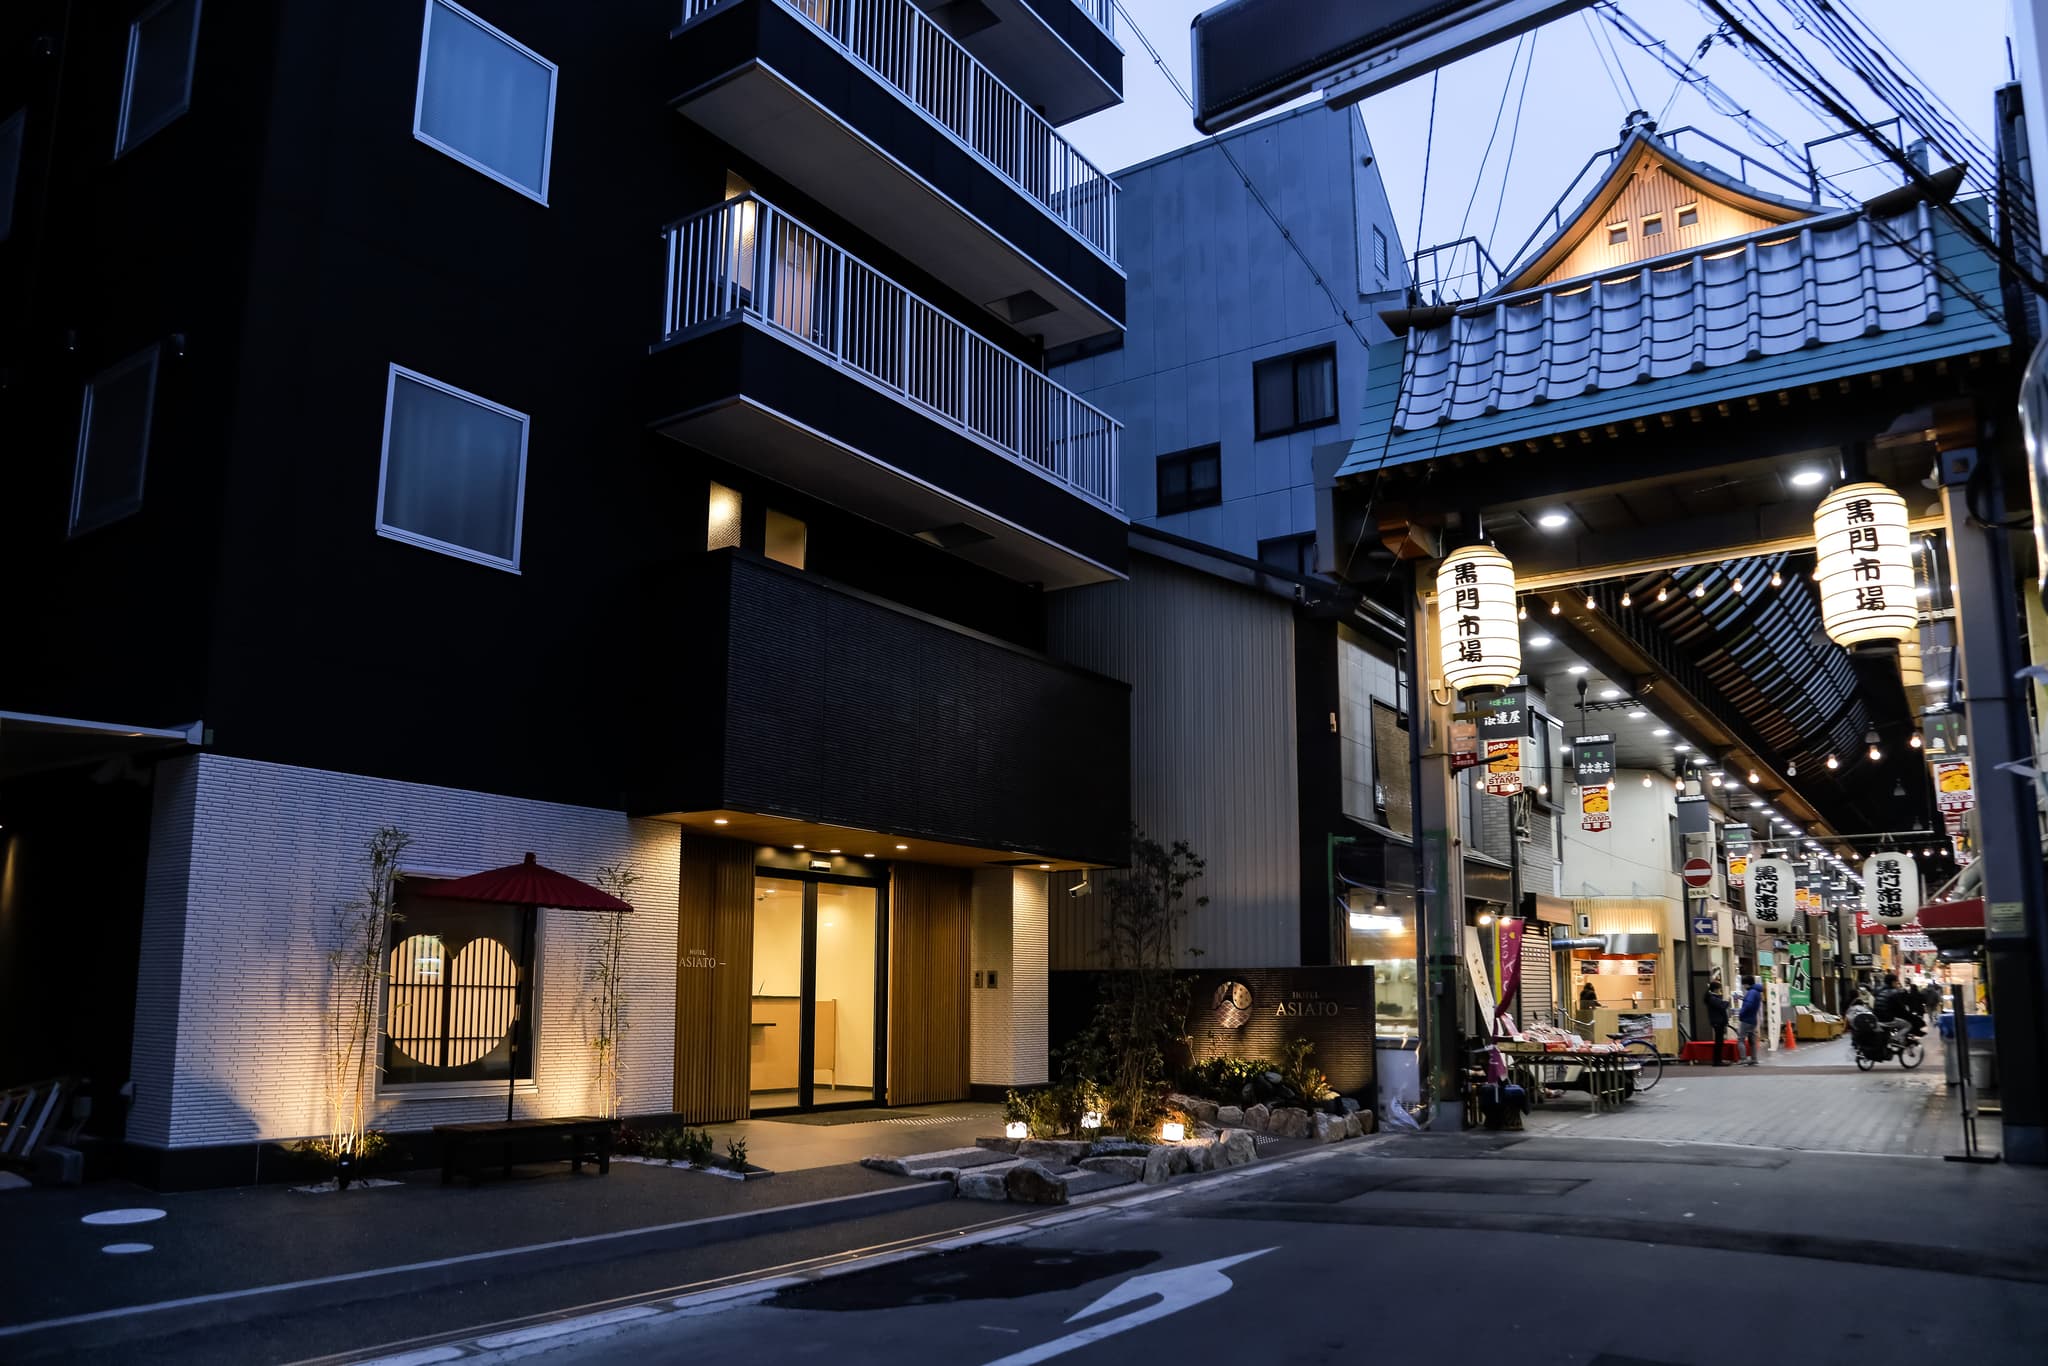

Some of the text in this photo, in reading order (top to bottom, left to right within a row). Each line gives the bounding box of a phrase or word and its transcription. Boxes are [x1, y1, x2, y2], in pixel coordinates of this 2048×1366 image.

[1845, 498, 1886, 611] 黒門市場
[1454, 561, 1482, 663] 黒門市場
[1488, 776, 1520, 785] STAMP
[679, 956, 716, 969] ASIATO
[1275, 1001, 1338, 1017] ASIATO
